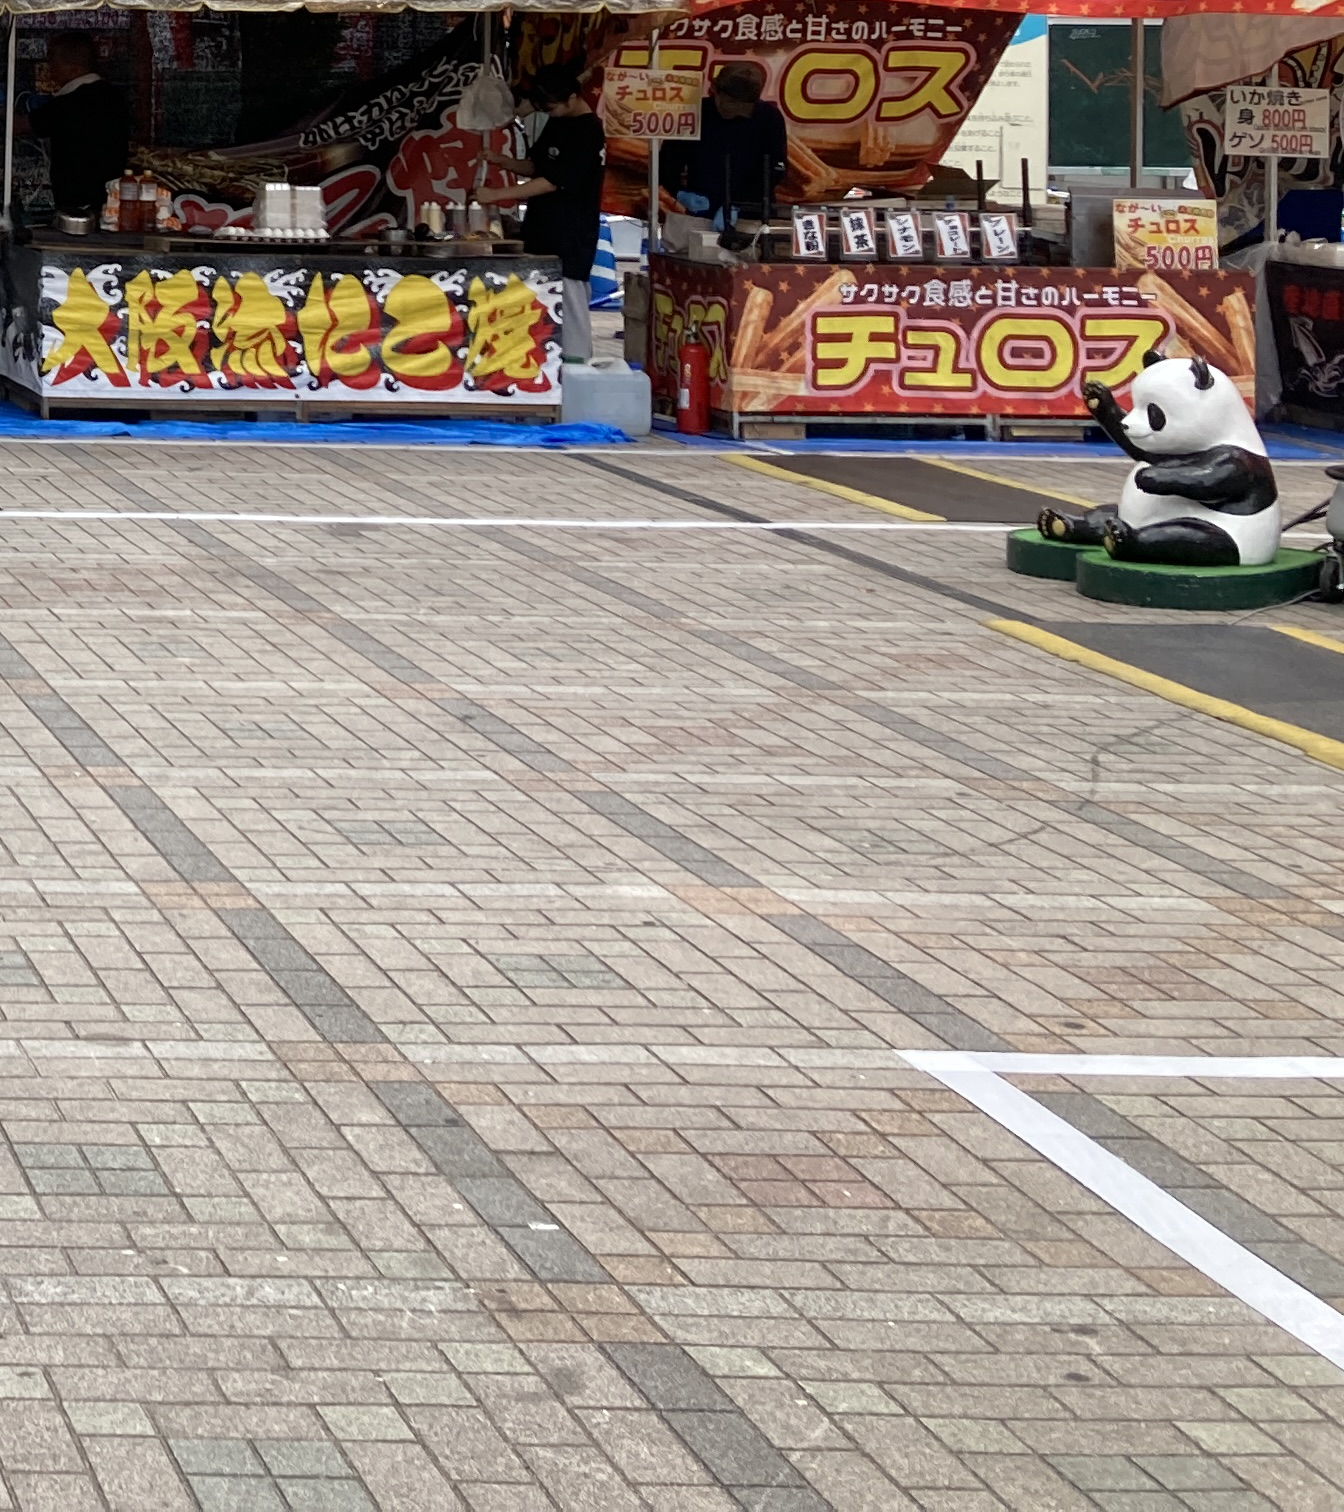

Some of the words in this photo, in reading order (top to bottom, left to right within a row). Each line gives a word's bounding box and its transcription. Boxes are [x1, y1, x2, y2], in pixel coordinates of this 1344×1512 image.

[615, 84, 685, 103] チュロス
[1229, 89, 1303, 107] いか焼き
[631, 111, 697, 135] 500円
[1262, 108, 1307, 128] 800円
[1229, 132, 1264, 149] ゲソ
[1271, 134, 1313, 152] 500円
[1127, 217, 1201, 235] チュロス
[1145, 244, 1213, 269] 500円
[840, 279, 1157, 308] サクサク食感と甘さのハーモニー
[814, 311, 1171, 392] チュロス
